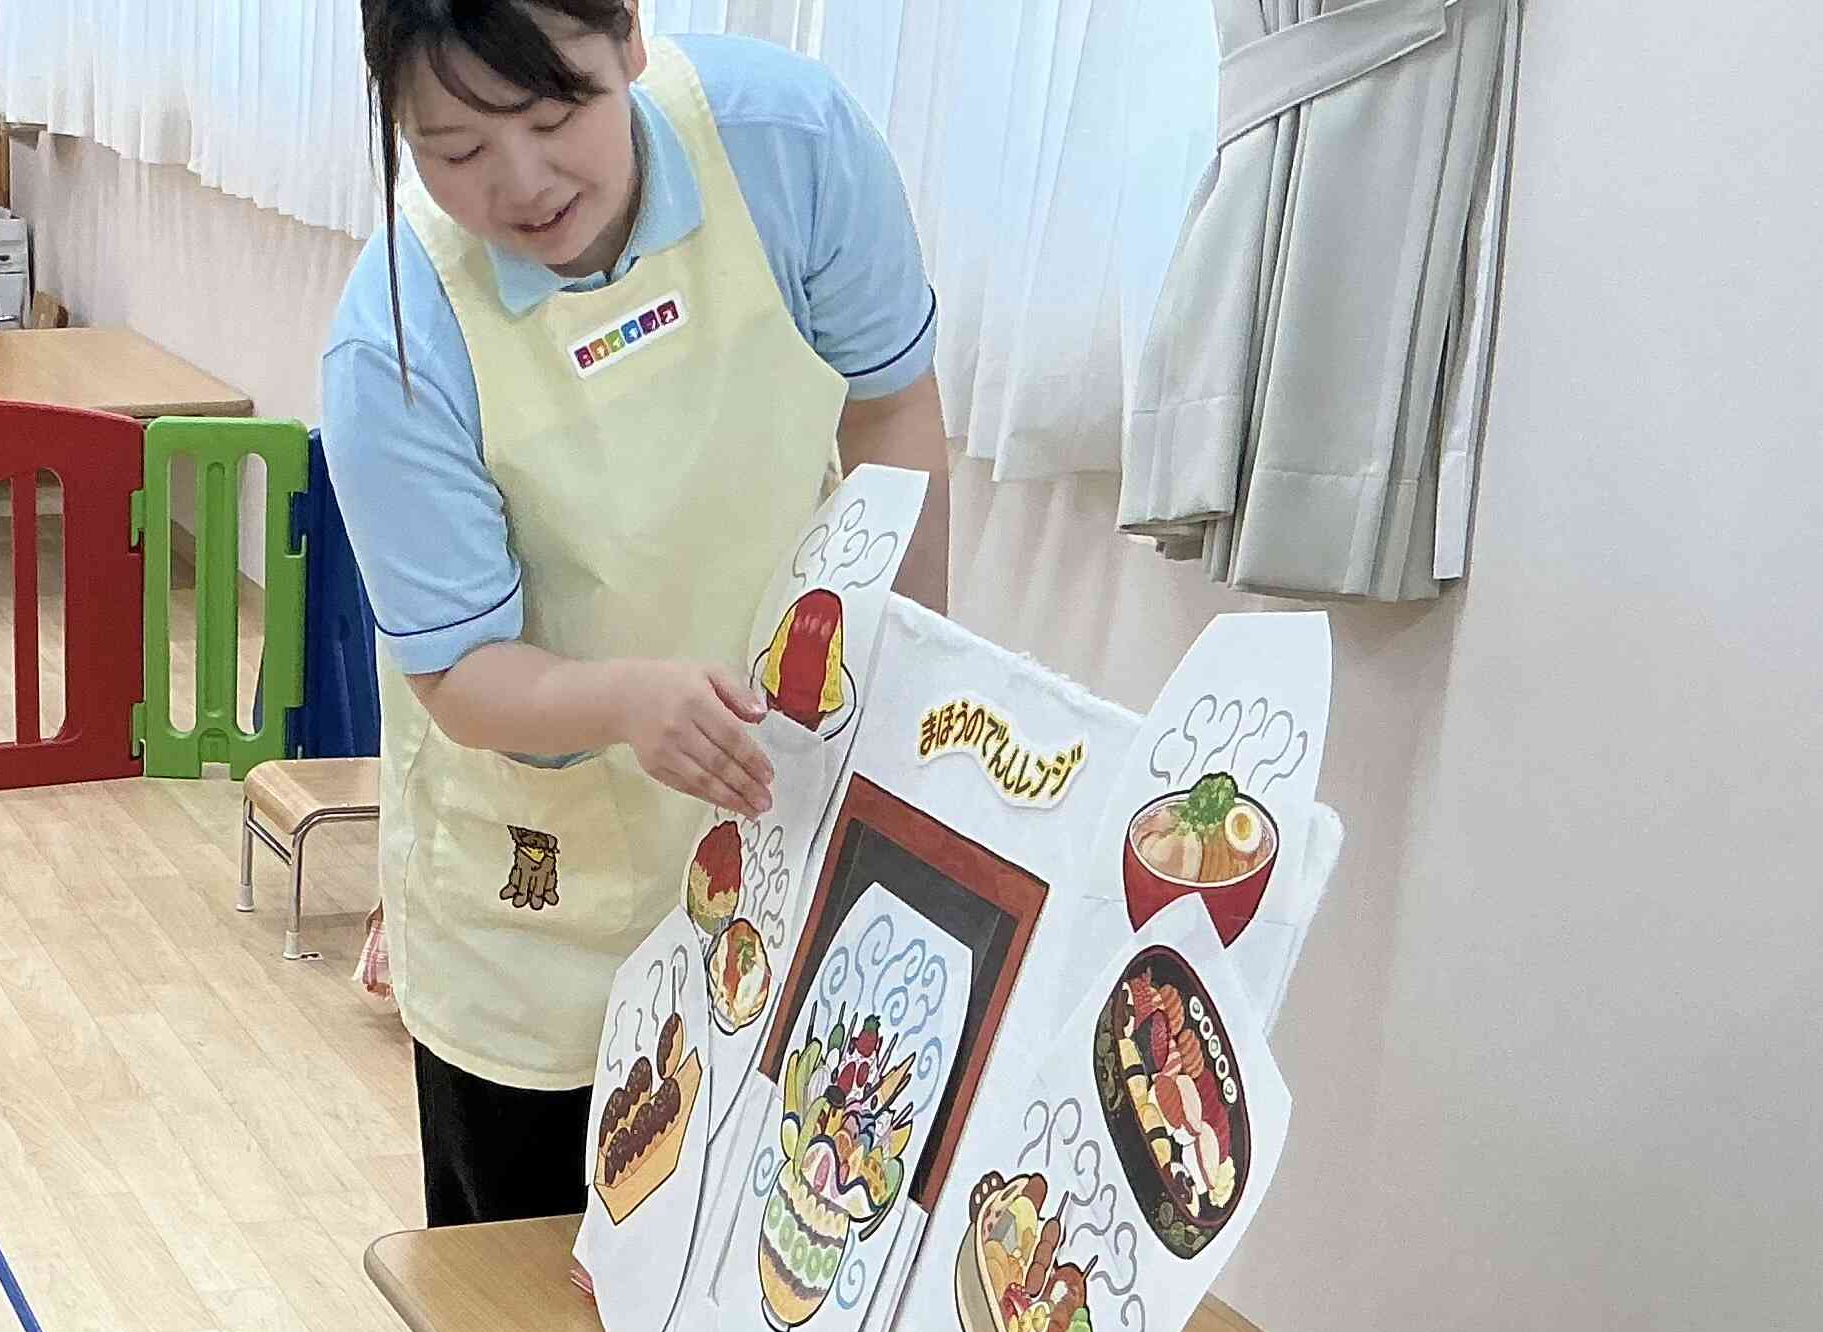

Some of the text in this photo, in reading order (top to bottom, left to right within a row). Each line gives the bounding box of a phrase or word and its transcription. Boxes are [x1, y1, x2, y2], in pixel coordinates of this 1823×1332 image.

[920, 697, 1082, 798] まほうのでんしレンジ
